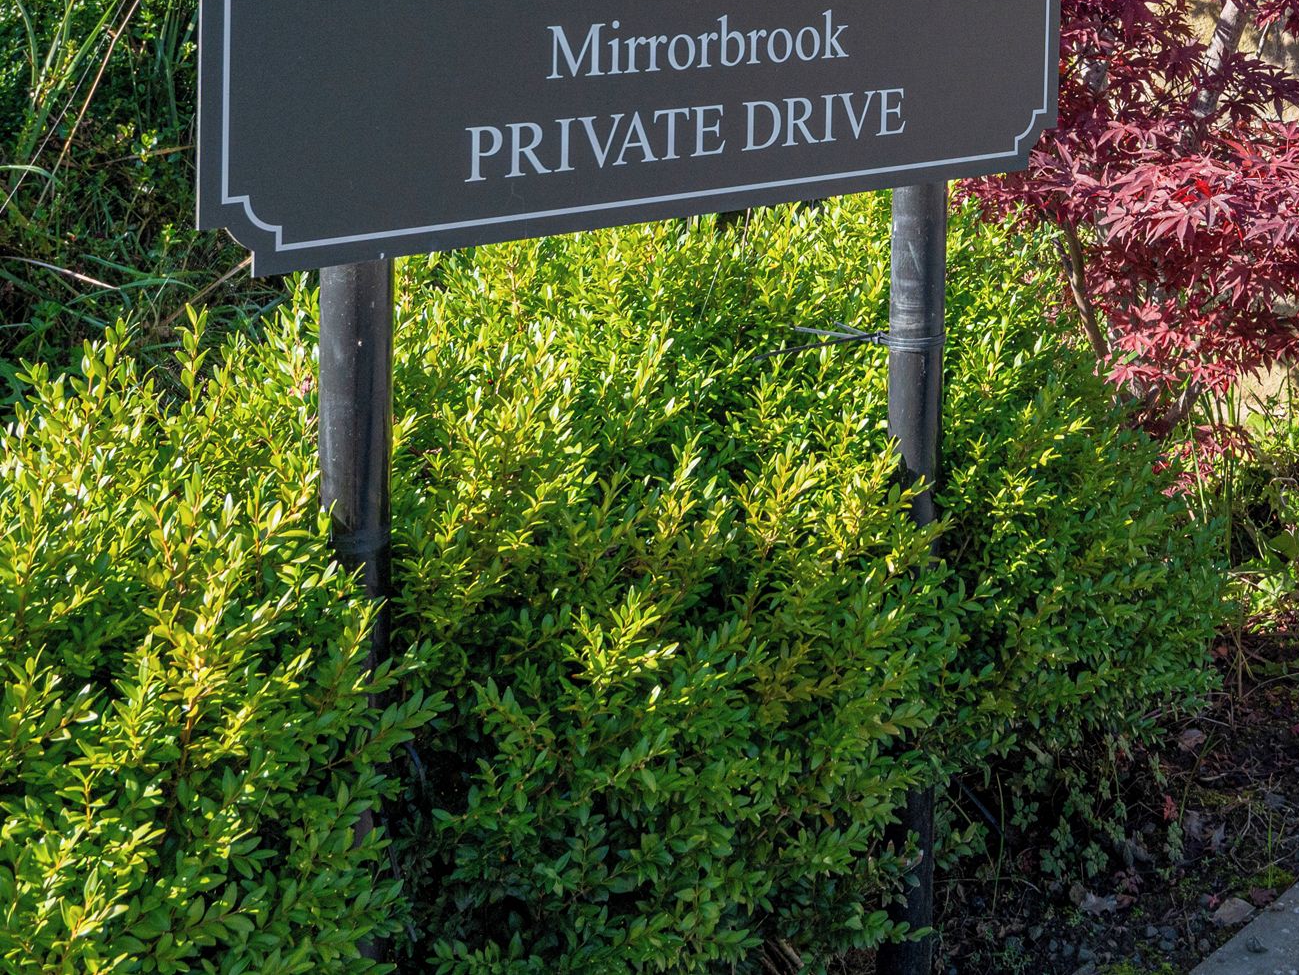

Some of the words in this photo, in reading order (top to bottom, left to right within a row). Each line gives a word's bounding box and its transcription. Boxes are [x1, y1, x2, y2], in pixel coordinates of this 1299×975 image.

[547, 10, 849, 79] Mirrorbrook
[465, 105, 725, 182] PRIVATE
[742, 88, 905, 151] DRIVE
